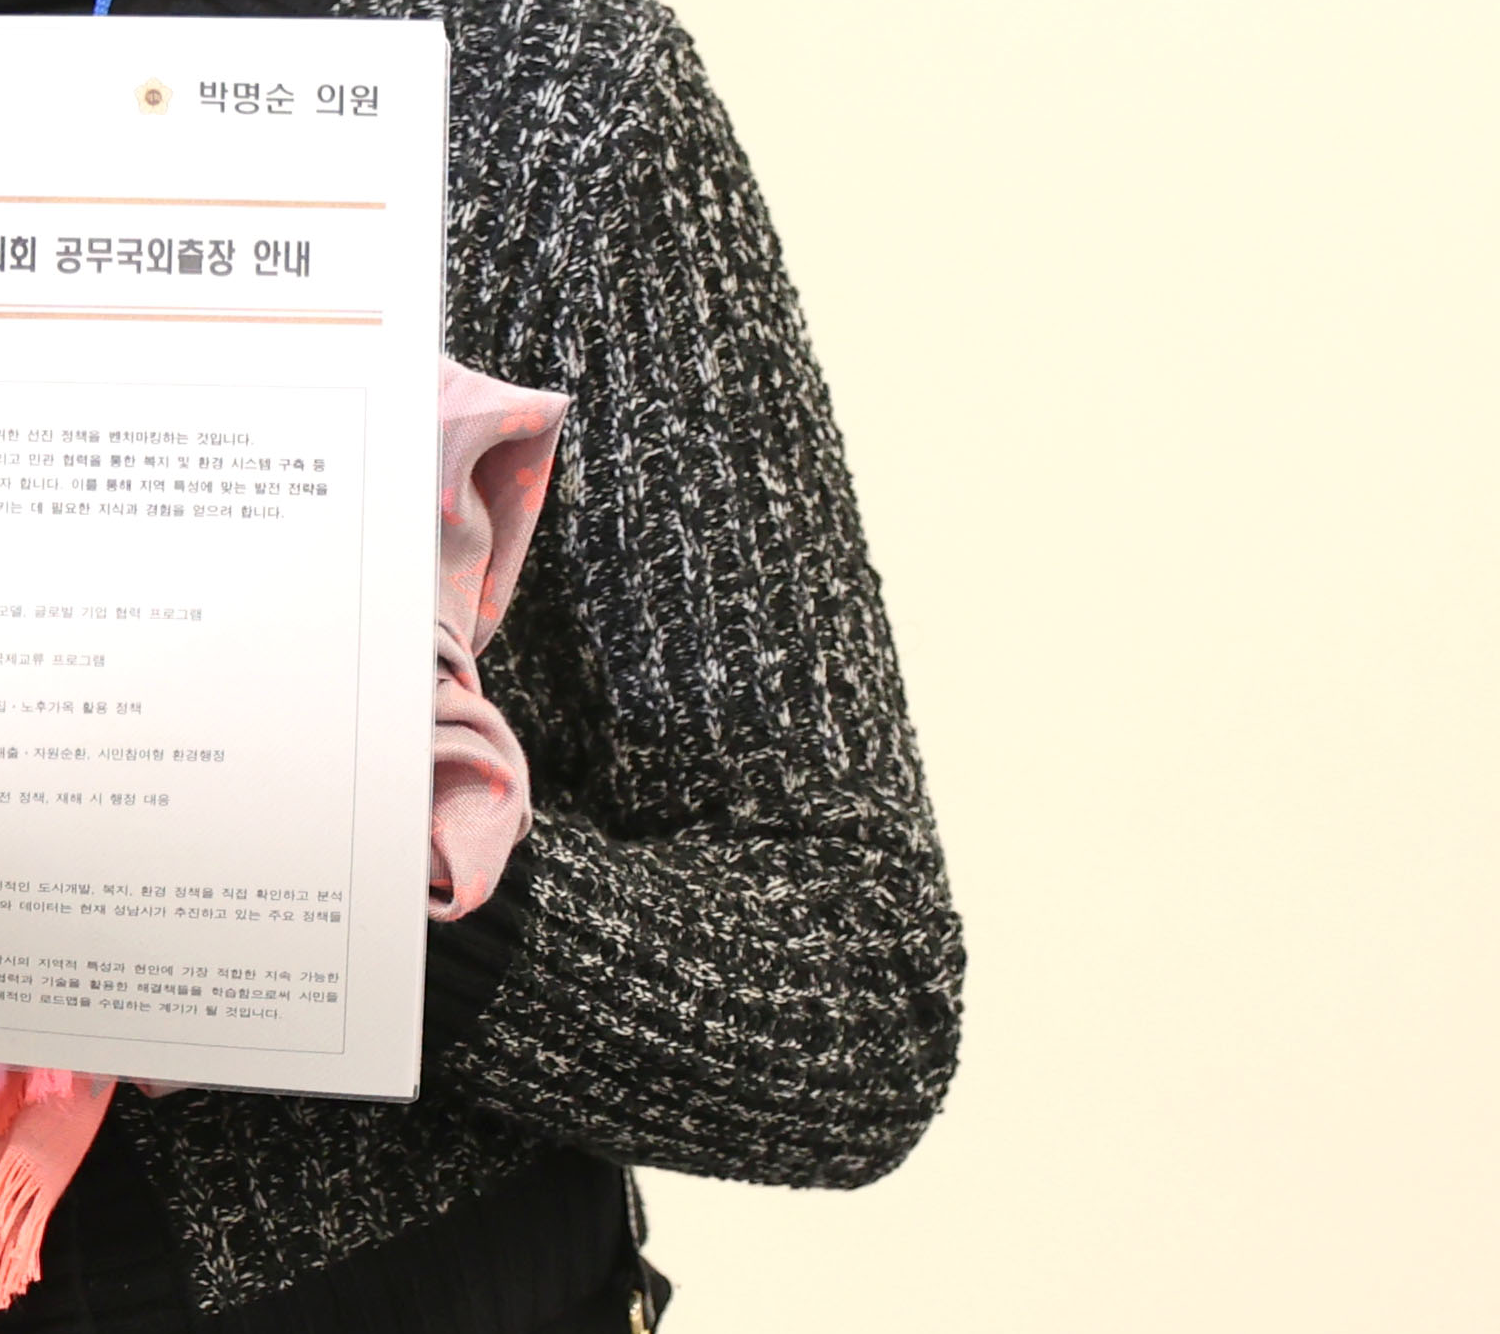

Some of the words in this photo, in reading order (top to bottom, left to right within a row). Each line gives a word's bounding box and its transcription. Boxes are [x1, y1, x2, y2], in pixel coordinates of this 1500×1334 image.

[200, 81, 294, 115] 박명순
[316, 84, 378, 117] 의원
[56, 236, 236, 276] 공무국외출장
[253, 238, 311, 278] 안내
[98, 747, 164, 762] 시민참여형
[173, 749, 224, 762] 환경행정
